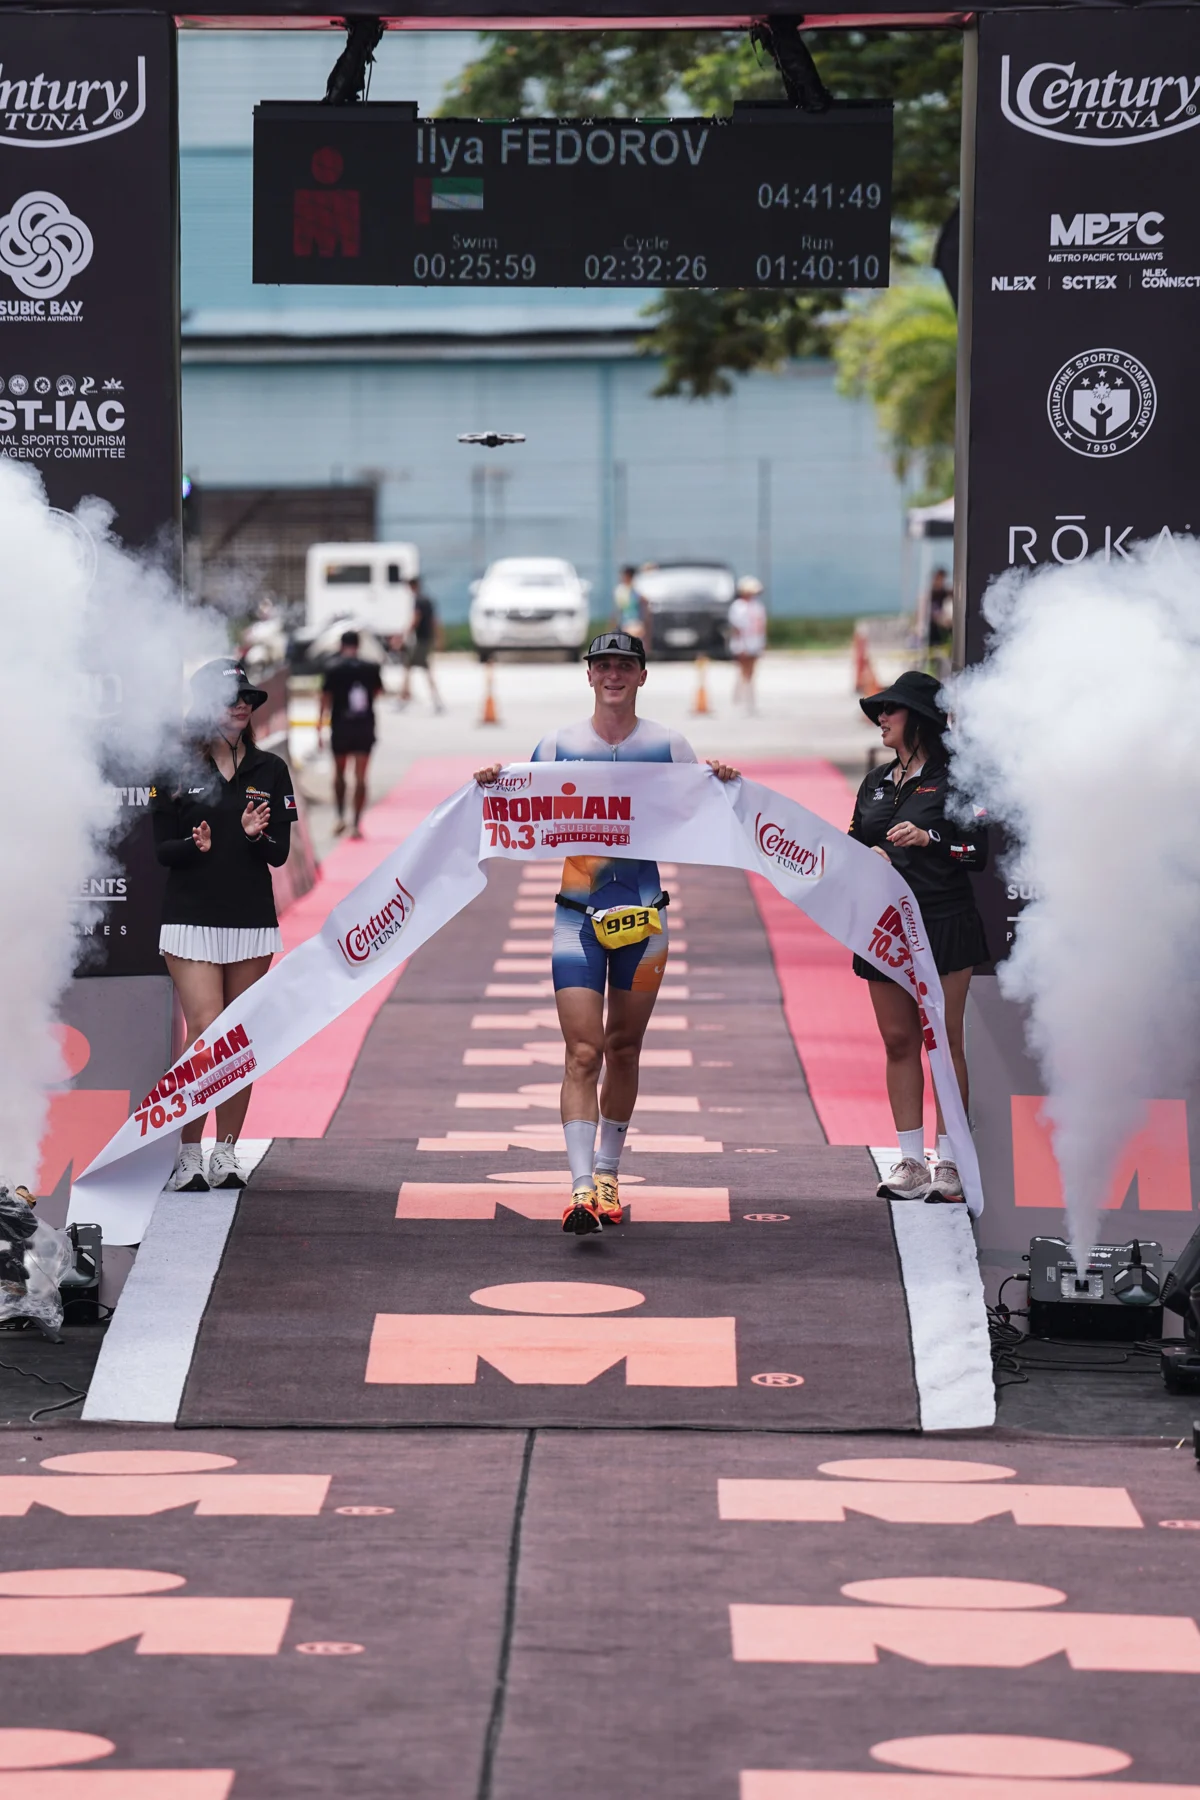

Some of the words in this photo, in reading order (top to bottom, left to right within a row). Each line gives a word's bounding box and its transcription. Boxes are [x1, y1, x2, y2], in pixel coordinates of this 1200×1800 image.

[0, 71, 128, 125] ntury
[1016, 61, 1200, 126] Century
[4, 112, 89, 131] TUNA
[1074, 109, 1160, 129] TUNA
[416, 127, 484, 173] Ilya
[501, 128, 709, 166] FEDOROV
[757, 182, 882, 209] 04:41:49
[1050, 211, 1165, 246] MPTC
[452, 234, 499, 250] Swim
[623, 234, 669, 253] Cycle
[801, 235, 834, 251] Run
[413, 254, 536, 280] 00:25:59
[584, 254, 707, 281] 02:32:26
[756, 254, 880, 281] 01:40:10
[1048, 253, 1081, 263] METRO
[1082, 253, 1115, 262] PACIFIC
[1117, 252, 1164, 262] TOLLWAYS
[991, 276, 1037, 291] NLEX
[1061, 275, 1118, 290] SCTEX
[1142, 268, 1168, 278] NLEX
[0, 300, 45, 316] SUBIC
[50, 300, 84, 316] BAY
[47, 315, 84, 323] AUTHORITY
[1052, 366, 1075, 429] PHILIPPINE
[1075, 353, 1120, 370] SPORTS
[1123, 359, 1153, 428] COMMISSION
[0, 400, 126, 432] ST-IAC
[1, 447, 52, 458] AGENCY
[54, 447, 126, 458] COMMITTEE
[21, 434, 69, 446] SPORTS
[72, 435, 126, 446] TOURISM
[1085, 442, 1117, 453] 1990
[483, 782, 632, 822] IRONMAN
[485, 823, 536, 850] 70.3
[548, 833, 627, 843] PHILIPPINES
[560, 824, 597, 833] SUBIC
[602, 824, 627, 833] BAY
[759, 822, 819, 875] Century
[776, 854, 804, 877] TUNA
[80, 878, 127, 894] ENTS
[345, 893, 406, 962] Century
[606, 910, 650, 935] 993
[370, 920, 402, 952] TUNA
[134, 1023, 250, 1114] RONMAN
[196, 1060, 255, 1101] PHILIPPINES
[202, 1067, 230, 1088] SUBIC
[233, 1050, 252, 1068] BAY
[134, 1093, 187, 1137] 70.3
